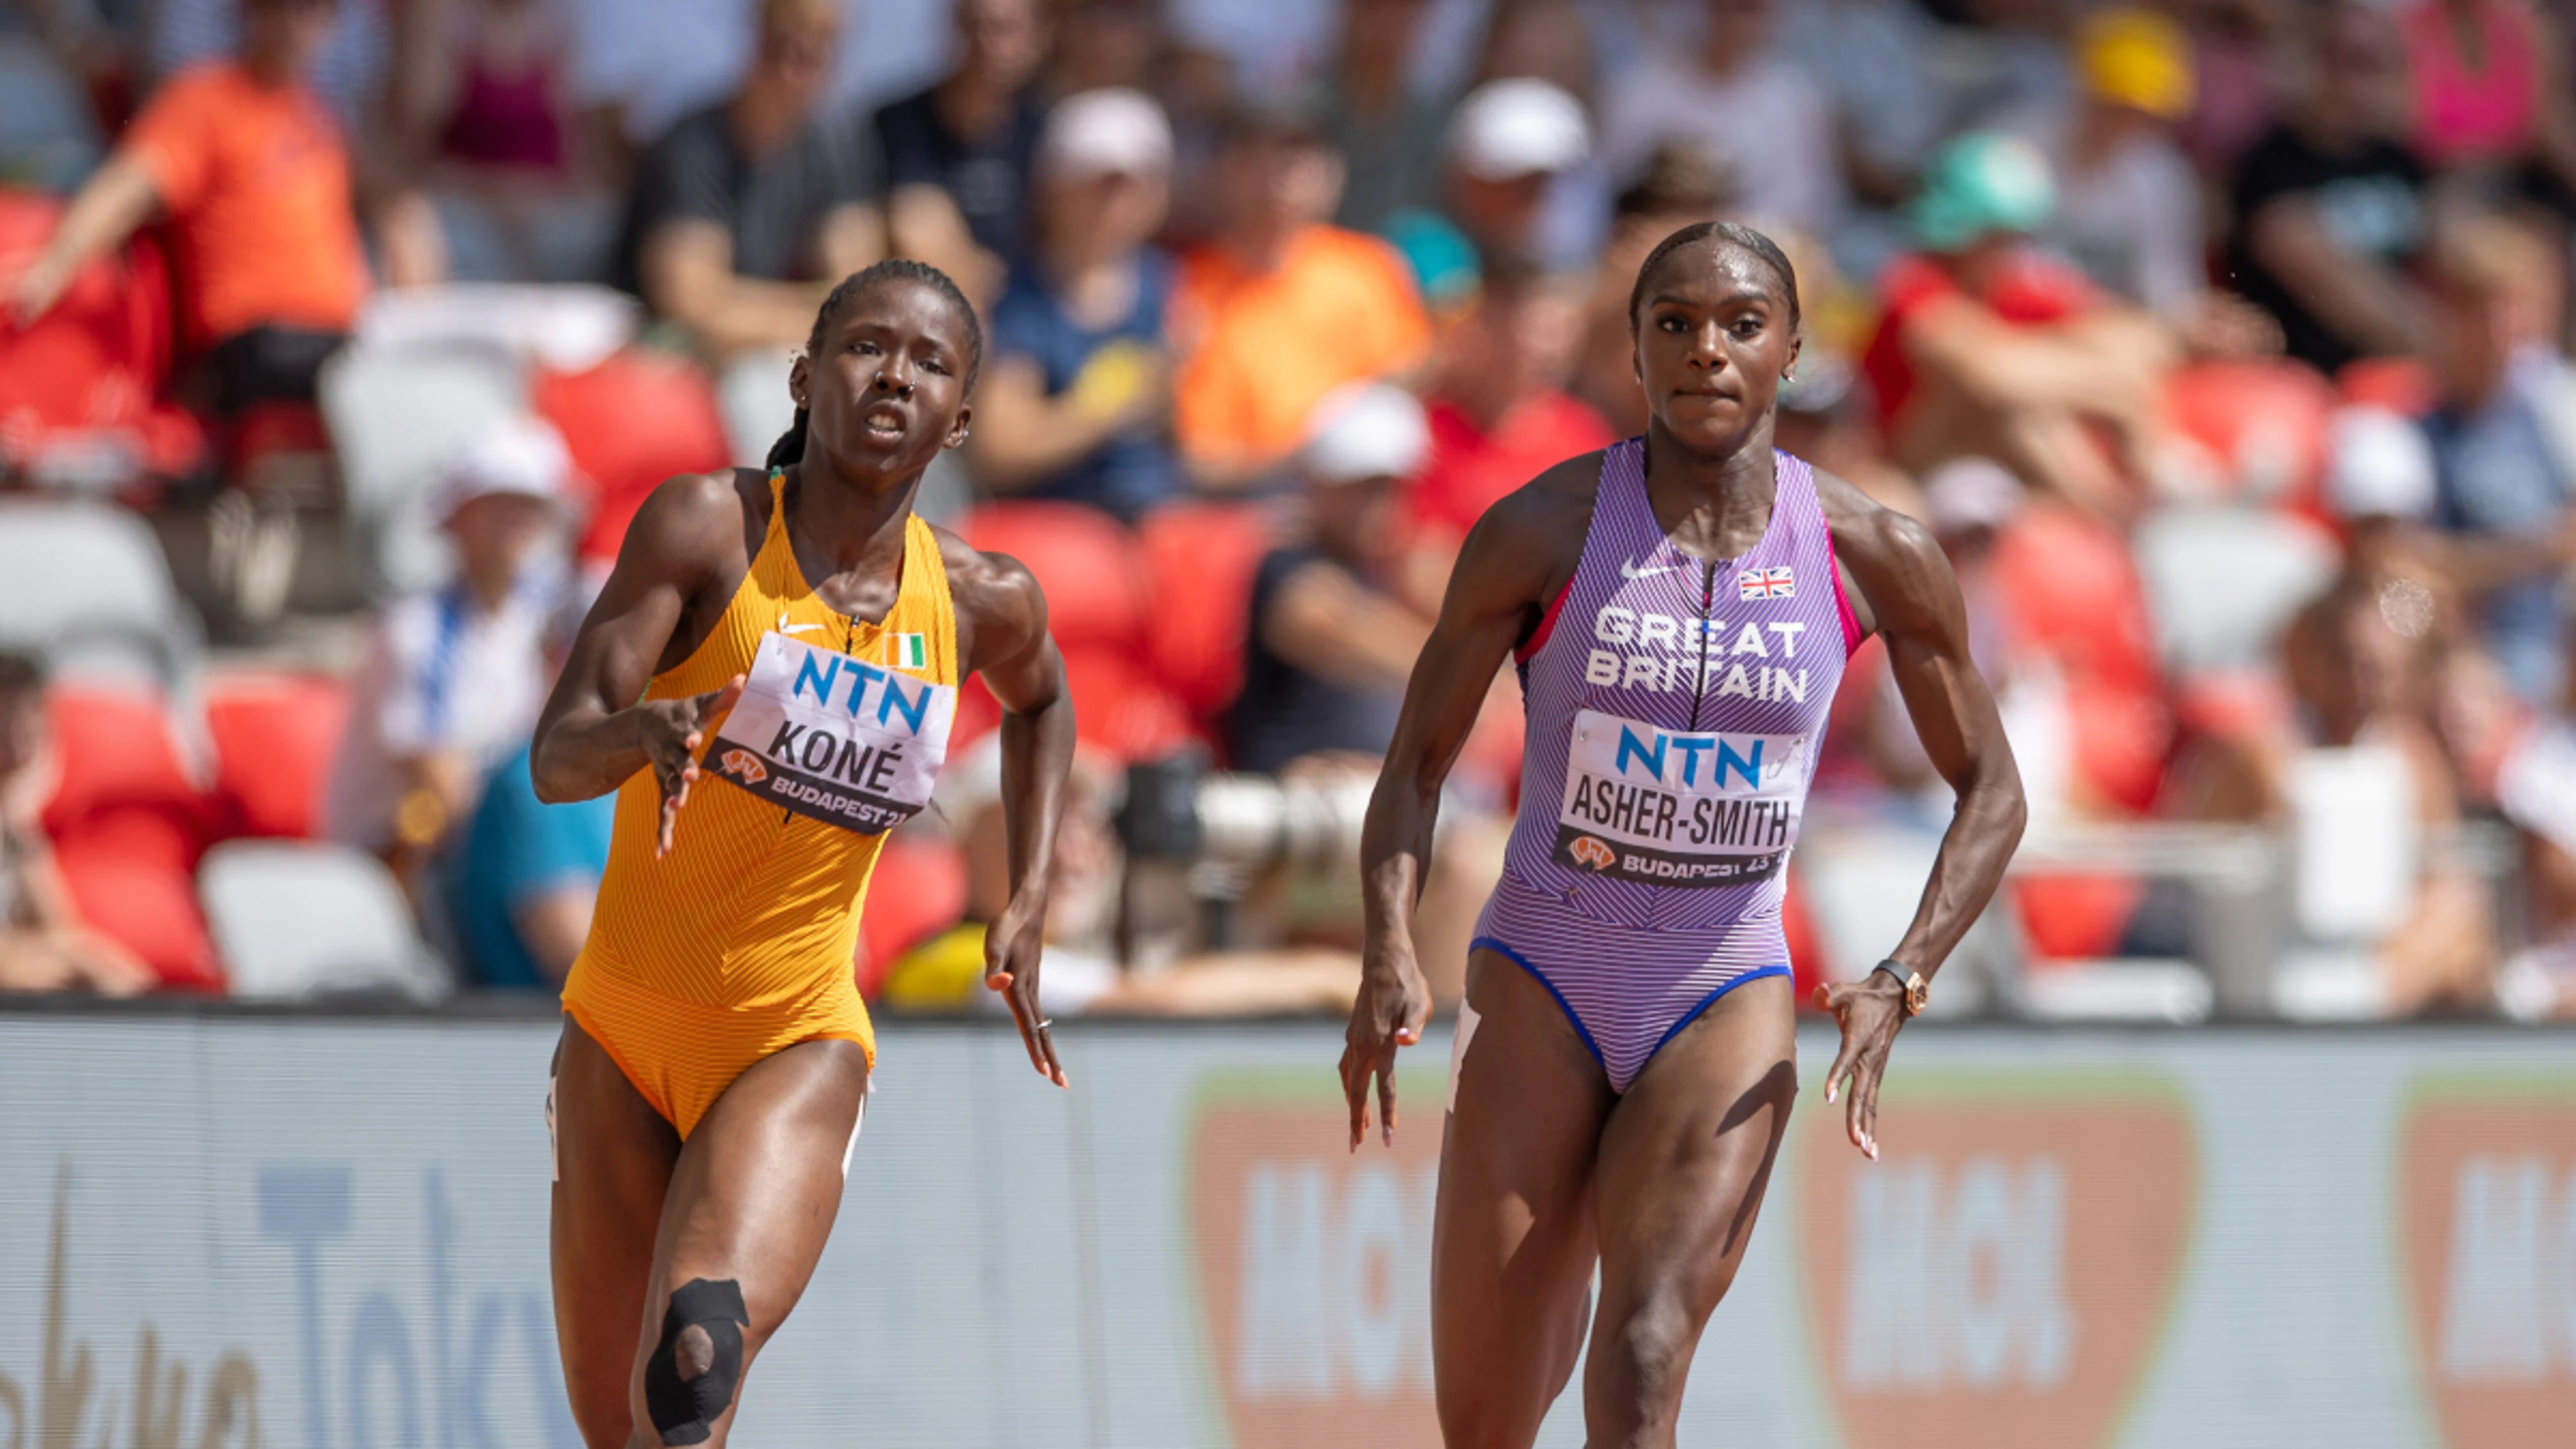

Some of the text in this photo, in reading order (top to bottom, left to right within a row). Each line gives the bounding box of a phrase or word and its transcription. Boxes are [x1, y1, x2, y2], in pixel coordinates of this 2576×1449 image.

[1595, 605, 1805, 658] GREAT
[793, 647, 933, 737] NTN
[1585, 648, 1807, 704] BRITAIN
[767, 720, 903, 794] KONÉ
[1615, 722, 1765, 792] NTN
[771, 775, 887, 825] BUDAPEST
[1570, 773, 1790, 847] ASHER-SMITH
[1238, 1163, 1437, 1401] MO
